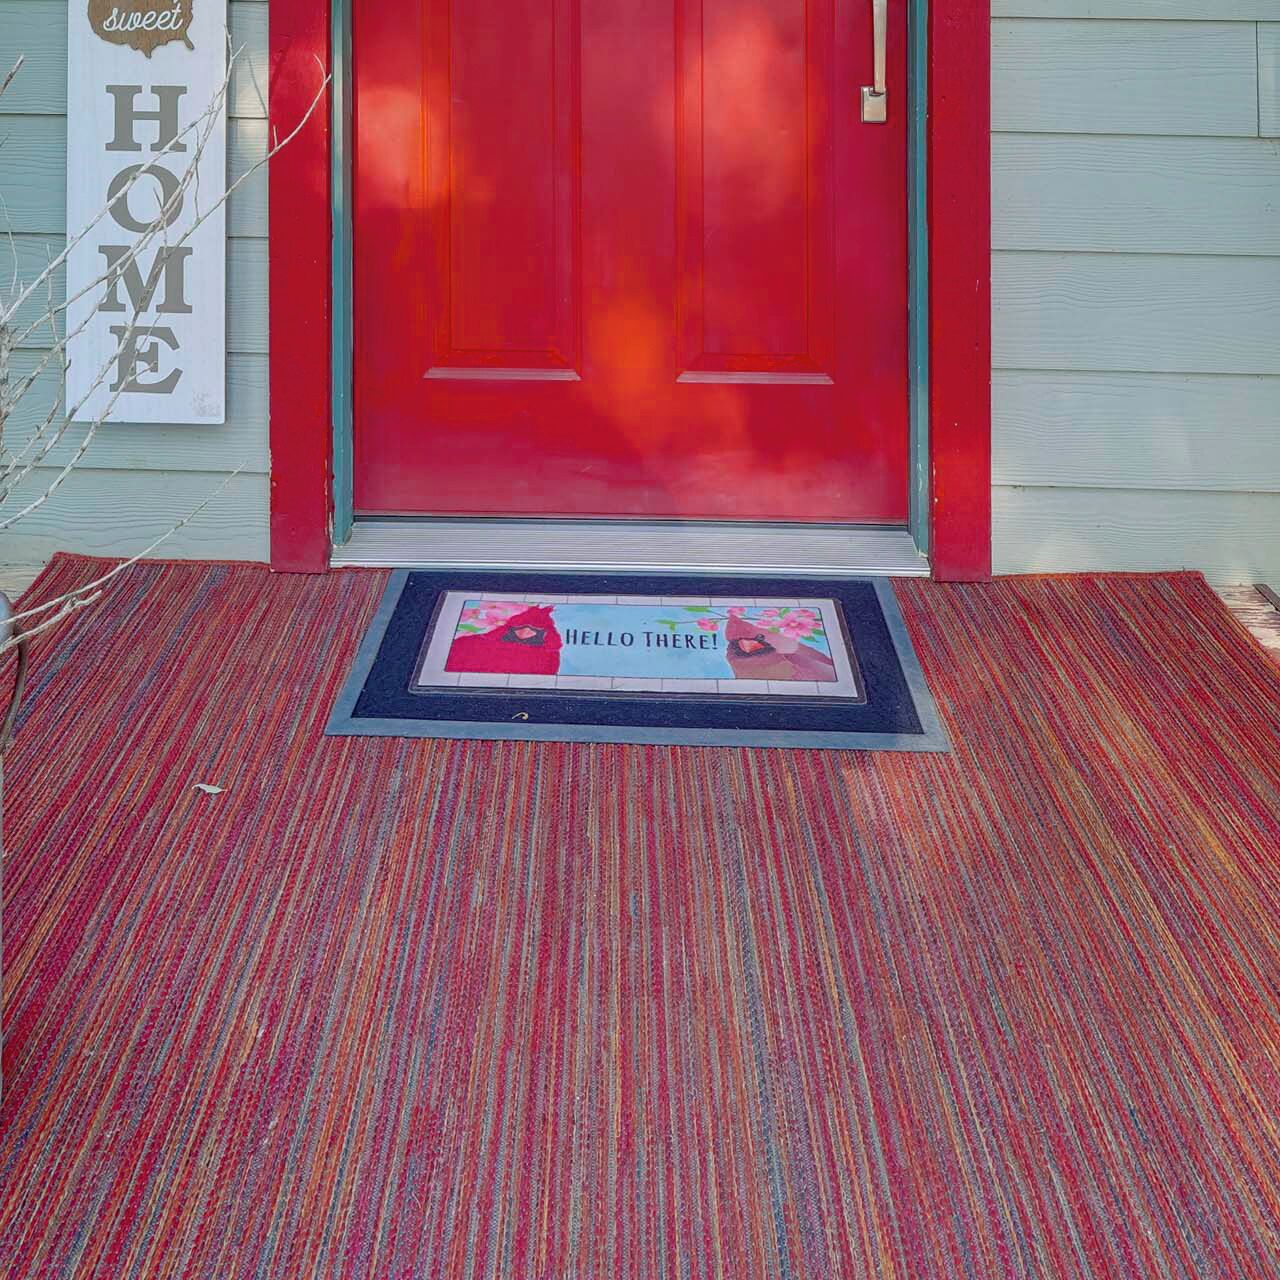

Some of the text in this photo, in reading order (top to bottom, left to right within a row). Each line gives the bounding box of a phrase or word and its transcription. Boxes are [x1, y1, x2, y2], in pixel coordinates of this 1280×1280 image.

[103, 3, 183, 32] sweet
[98, 83, 193, 395] HOME
[566, 628, 718, 650] HELLO THERE!
